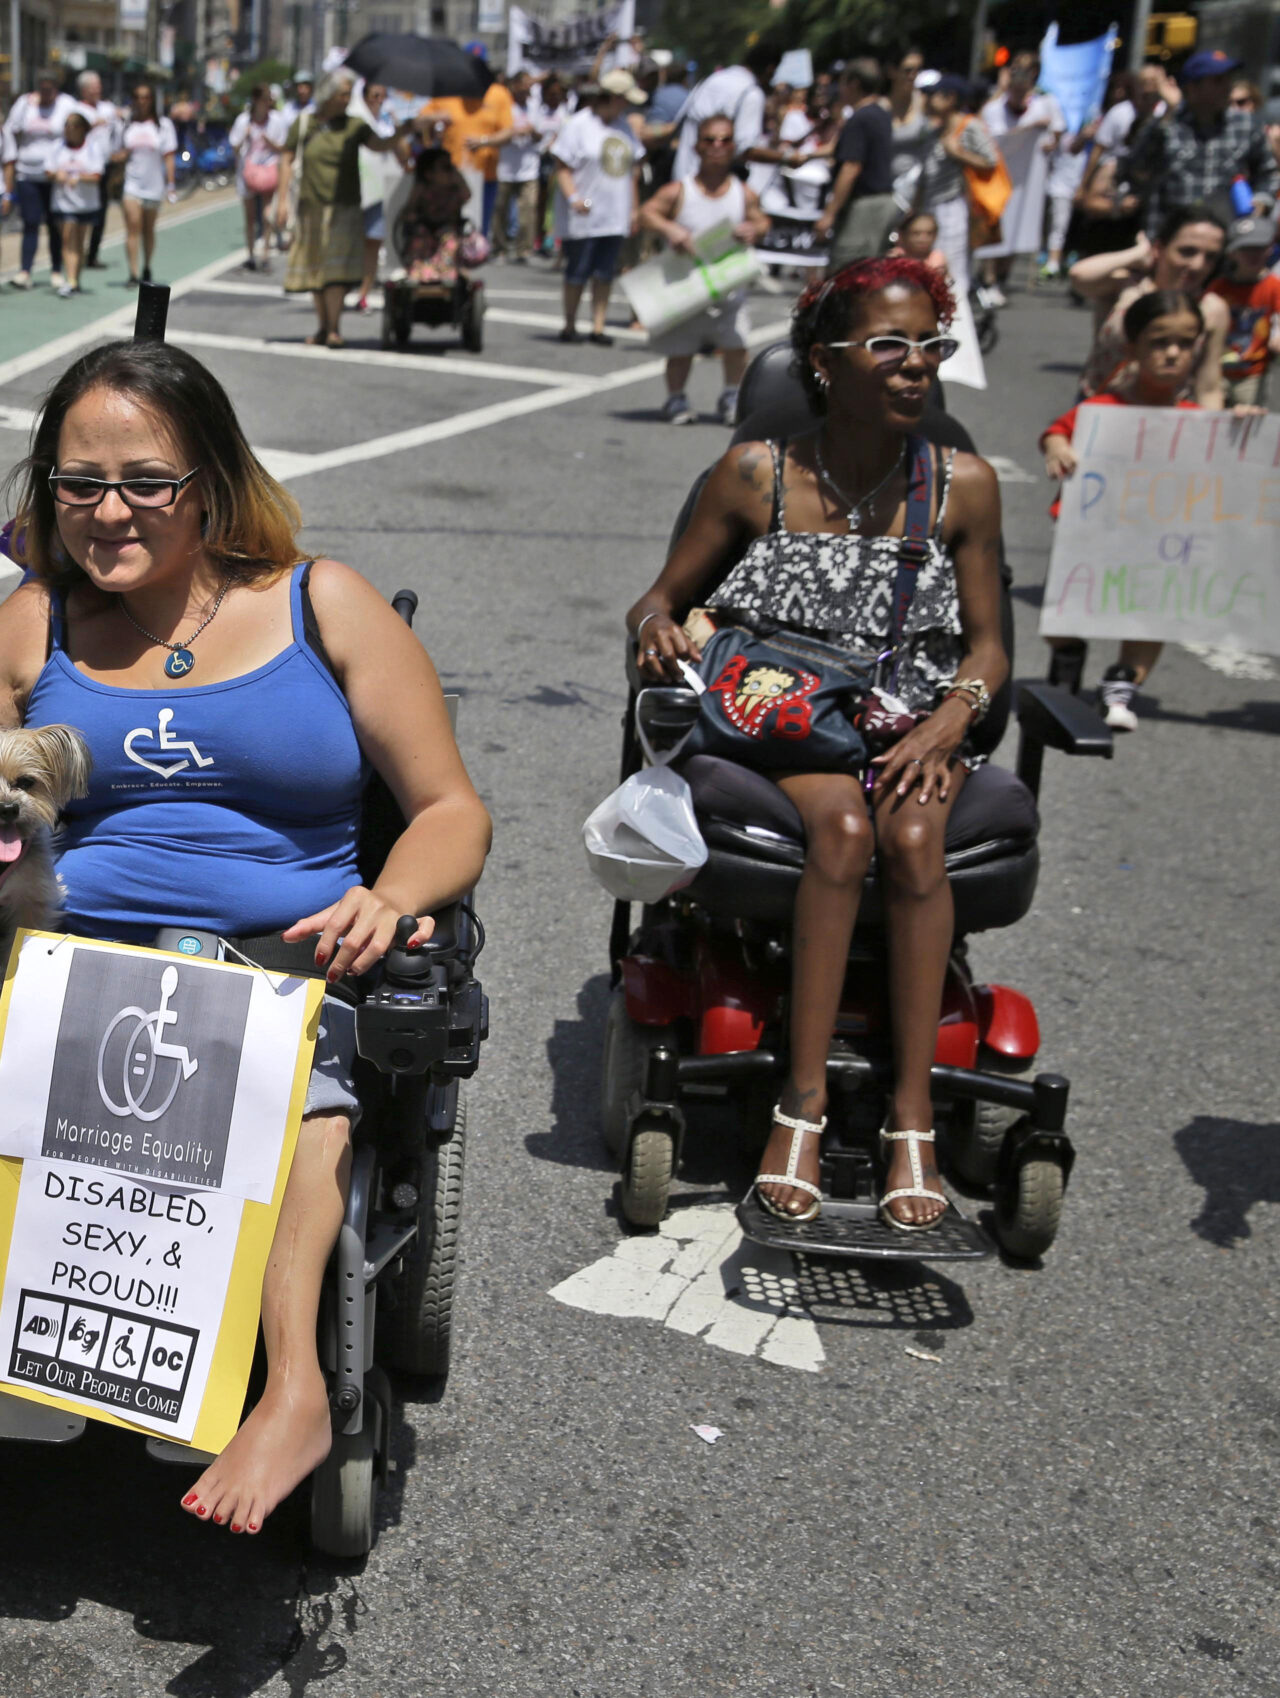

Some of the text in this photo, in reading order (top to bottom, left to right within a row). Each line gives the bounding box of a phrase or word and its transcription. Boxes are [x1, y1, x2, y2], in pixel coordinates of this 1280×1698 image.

[1084, 412, 1280, 468] LITTL
[1080, 470, 1280, 526] PEOPLE
[1157, 532, 1207, 565] OF
[46, 1149, 218, 1187] FOR PEOPLE WITH DISABILITIES
[55, 1118, 213, 1171] Marriage Equality
[44, 1171, 214, 1234] DISABLED,
[62, 1222, 182, 1269] SEXY, &
[51, 1261, 179, 1314] PROUD!!!
[152, 1346, 184, 1371] OC
